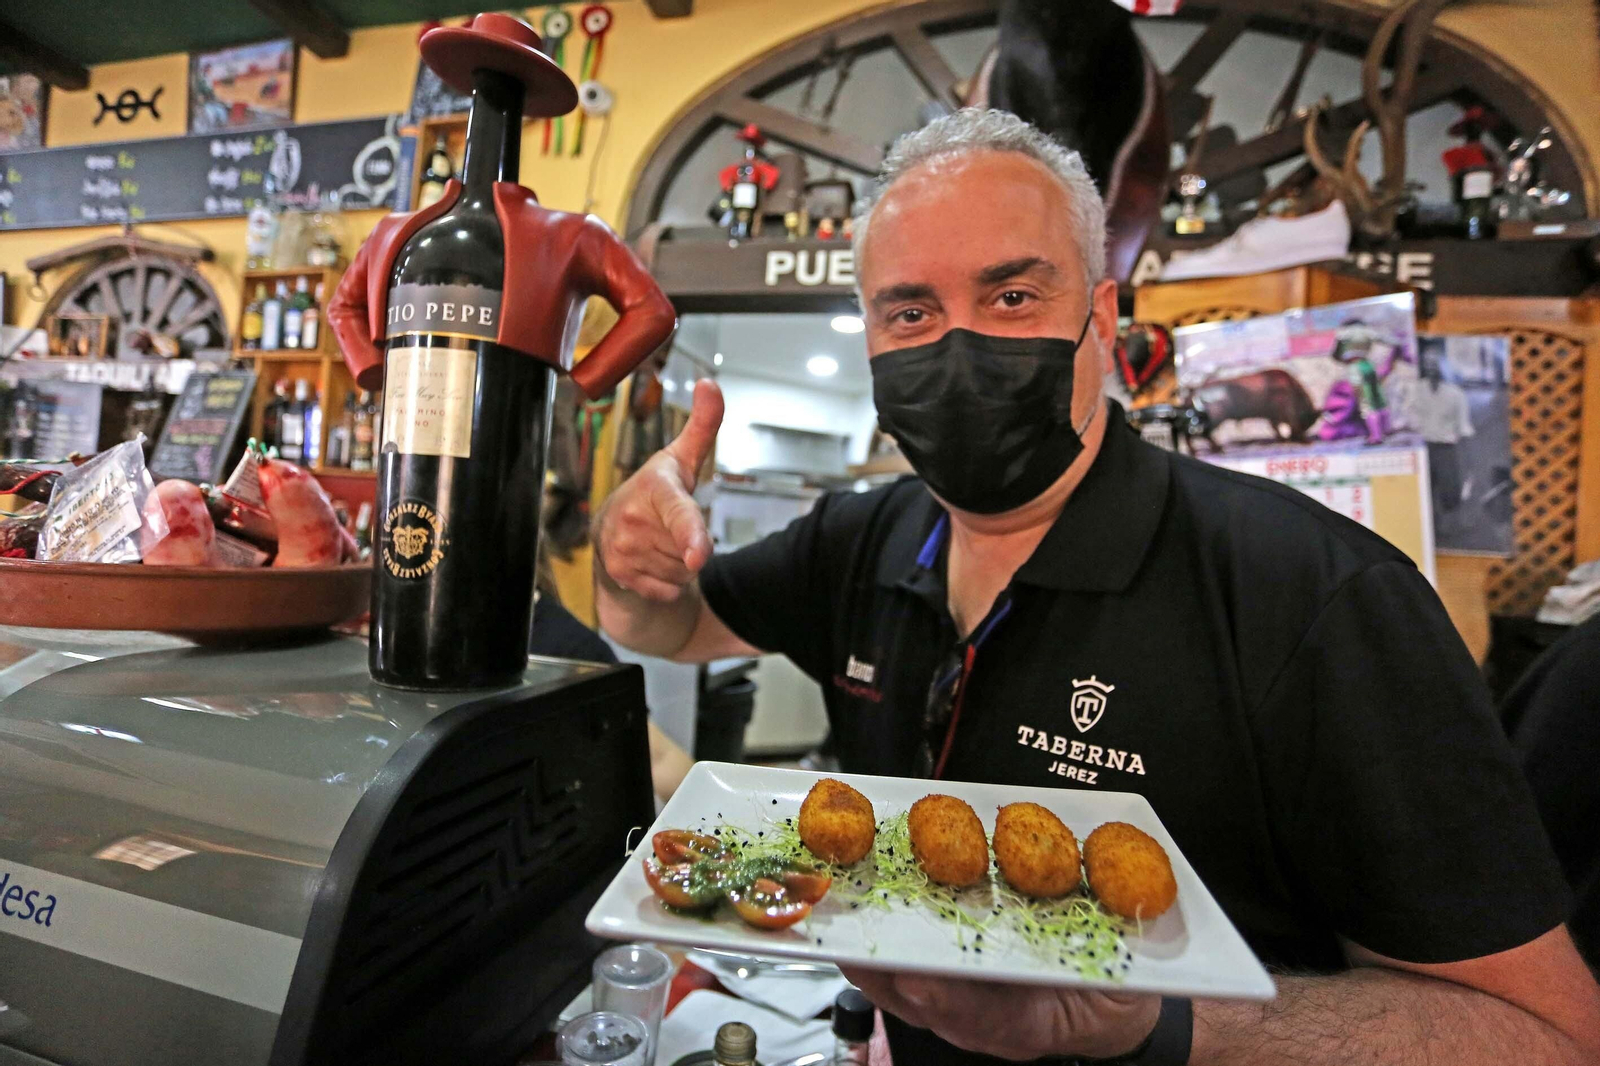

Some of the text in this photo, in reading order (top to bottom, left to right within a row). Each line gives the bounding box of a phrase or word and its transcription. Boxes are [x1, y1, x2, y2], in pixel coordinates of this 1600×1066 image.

[765, 250, 857, 286] PUE
[388, 302, 493, 326] TIO PEPE
[1266, 456, 1328, 476] ENERO
[1017, 725, 1146, 775] TABERNA
[1048, 761, 1099, 785] JEREZ
